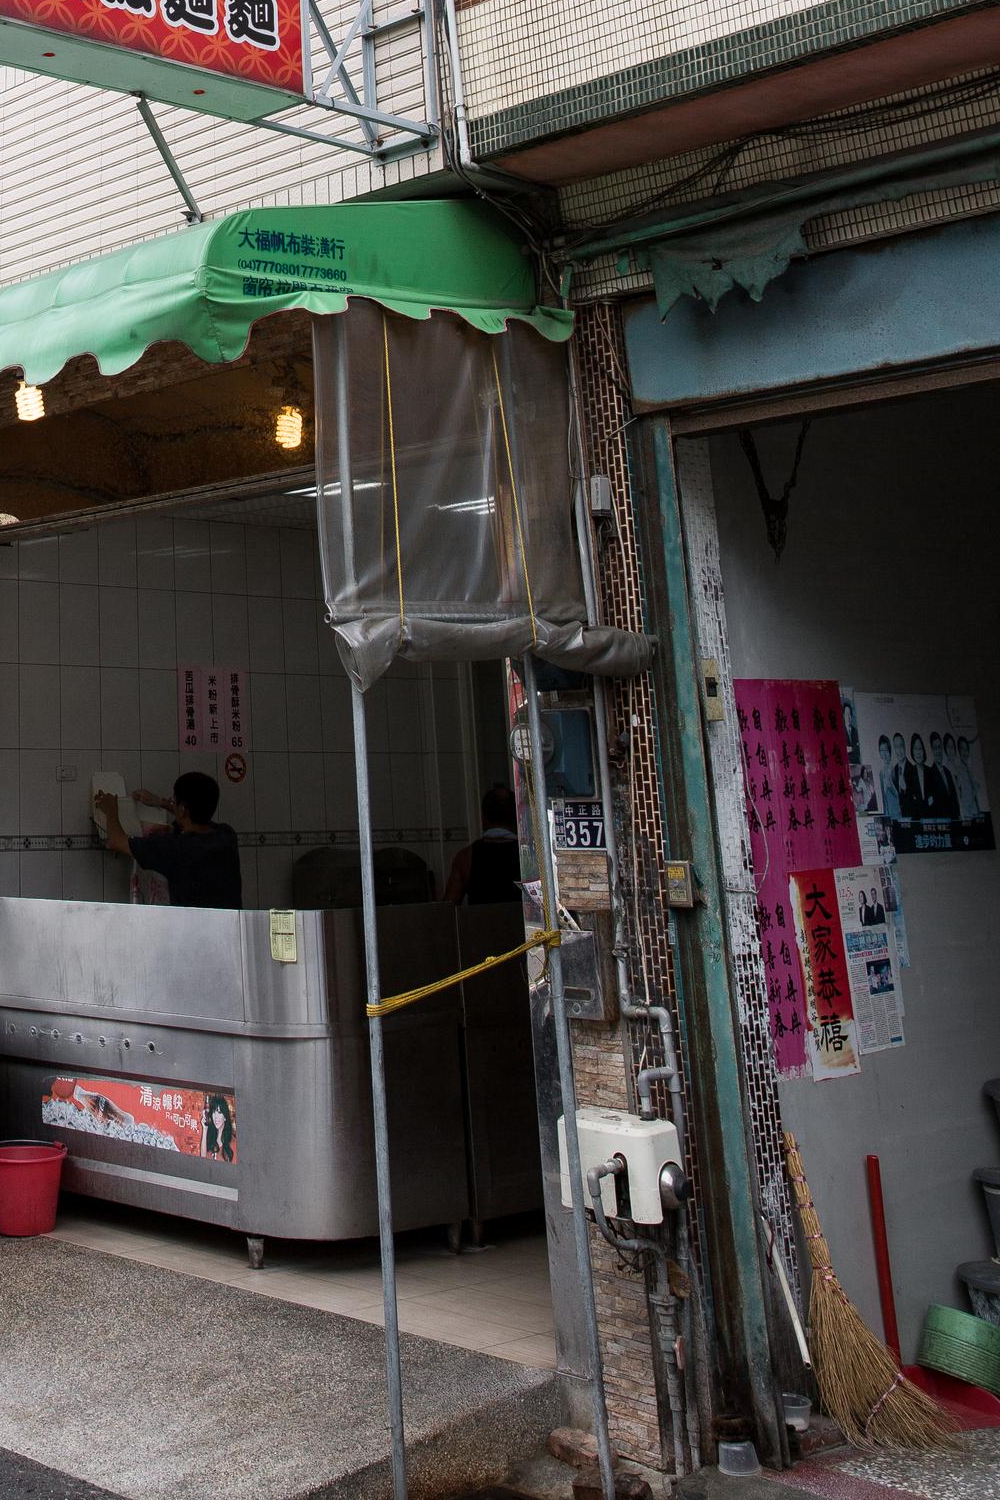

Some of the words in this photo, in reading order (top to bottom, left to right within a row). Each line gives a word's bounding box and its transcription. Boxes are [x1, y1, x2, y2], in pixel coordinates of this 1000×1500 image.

[238, 227, 345, 260] 大福帆布裝潢行
[208, 675, 219, 744] 米粉新上市
[185, 735, 197, 746] 40
[231, 736, 243, 748] 65
[565, 804, 601, 817] 中正路
[566, 821, 603, 846] 357
[805, 884, 848, 1052] 大家恭禧
[140, 1085, 183, 1111] 清涼暢快
